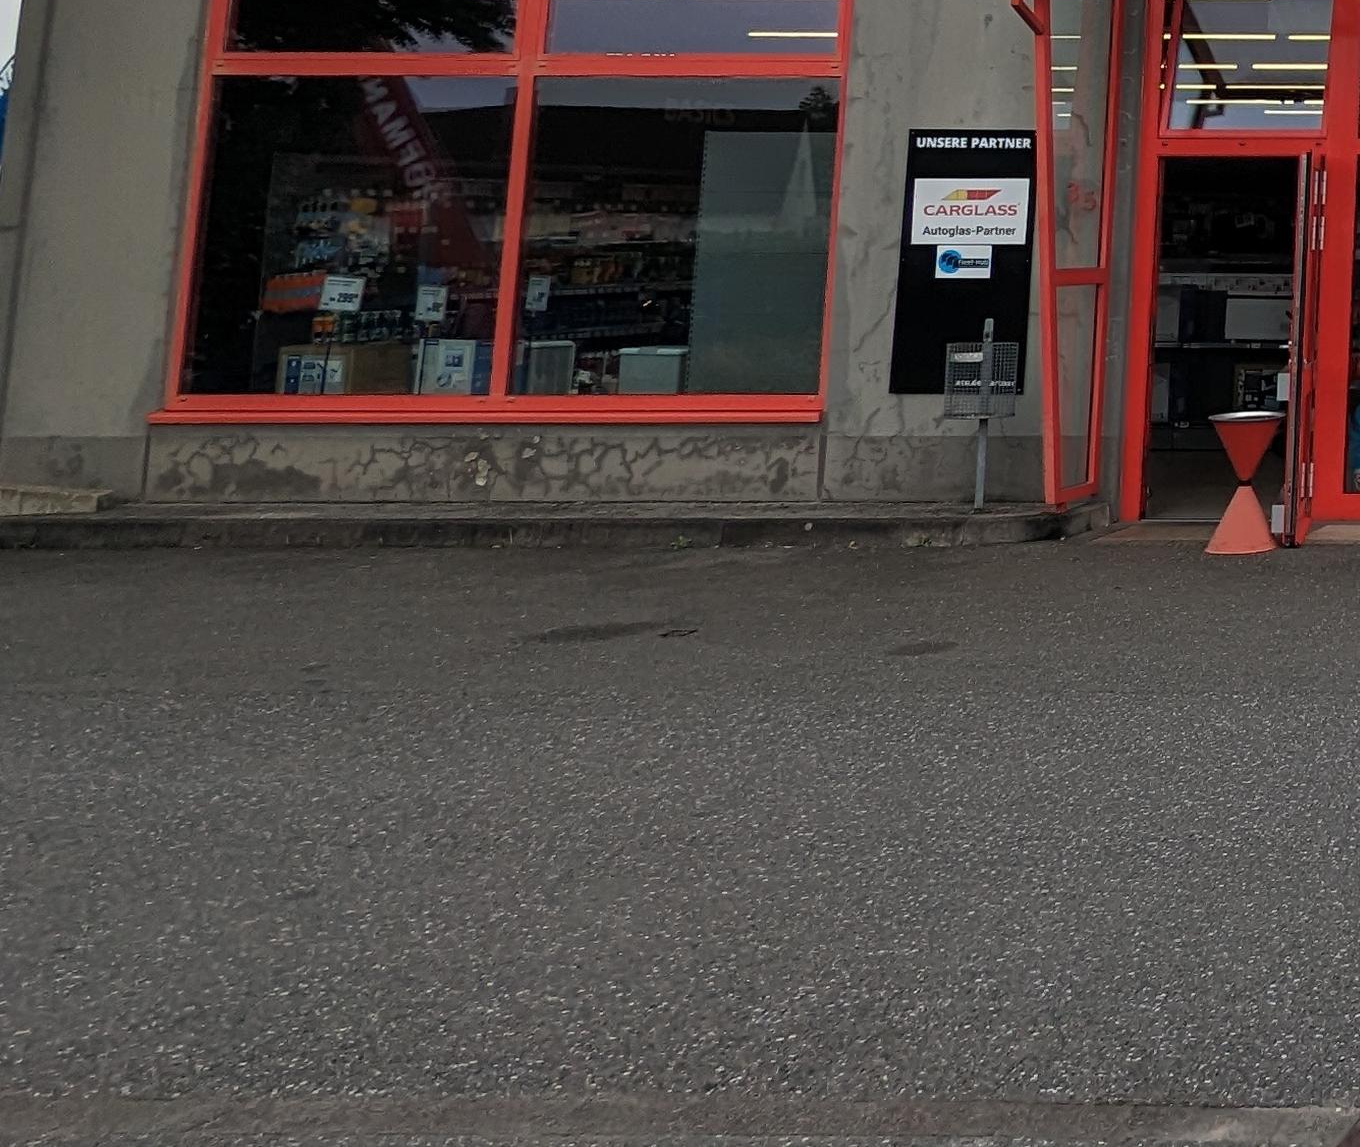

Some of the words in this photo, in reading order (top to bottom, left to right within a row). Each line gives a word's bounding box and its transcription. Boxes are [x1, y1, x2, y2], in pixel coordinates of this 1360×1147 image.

[916, 137, 967, 149] UNSERE
[971, 137, 1032, 150] PARTNER
[923, 204, 1017, 216] CARGLASS
[922, 225, 1017, 238] Autoglas-Partner
